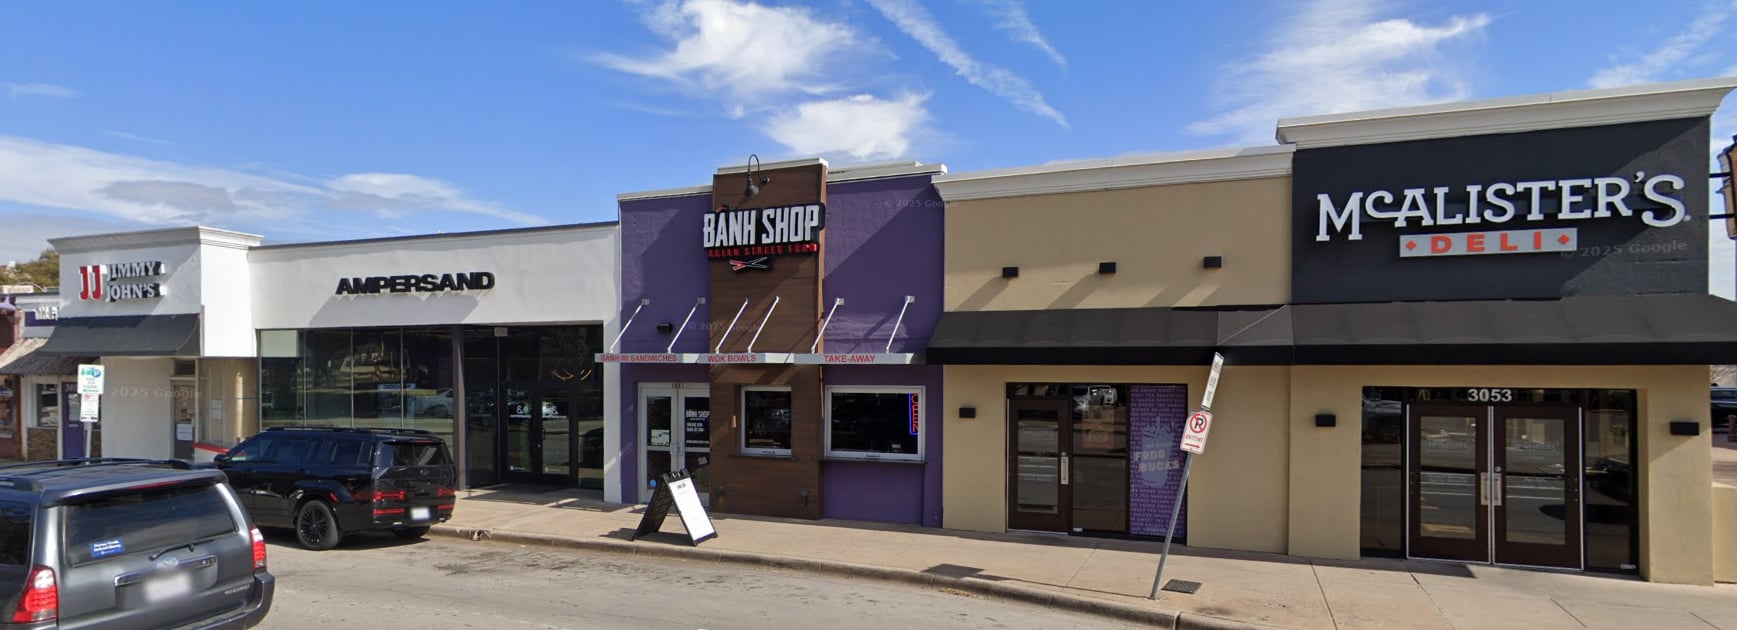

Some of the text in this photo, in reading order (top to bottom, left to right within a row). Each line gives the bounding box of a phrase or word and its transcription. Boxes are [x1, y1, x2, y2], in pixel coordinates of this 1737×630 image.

[761, 204, 819, 245] SHOP
[707, 243, 817, 258] ASIAN STREET FOOD
[1431, 230, 1543, 254] DELI
[106, 262, 156, 281] JIMMY
[79, 264, 103, 301] JJ
[335, 271, 496, 295] AMPERSAND
[105, 283, 156, 302] JOHN'S
[630, 354, 678, 362] SANDWICHES
[707, 354, 757, 363] WOK BOWLS
[824, 354, 876, 363] TAKE-AWAY
[1467, 388, 1513, 402] 3053
